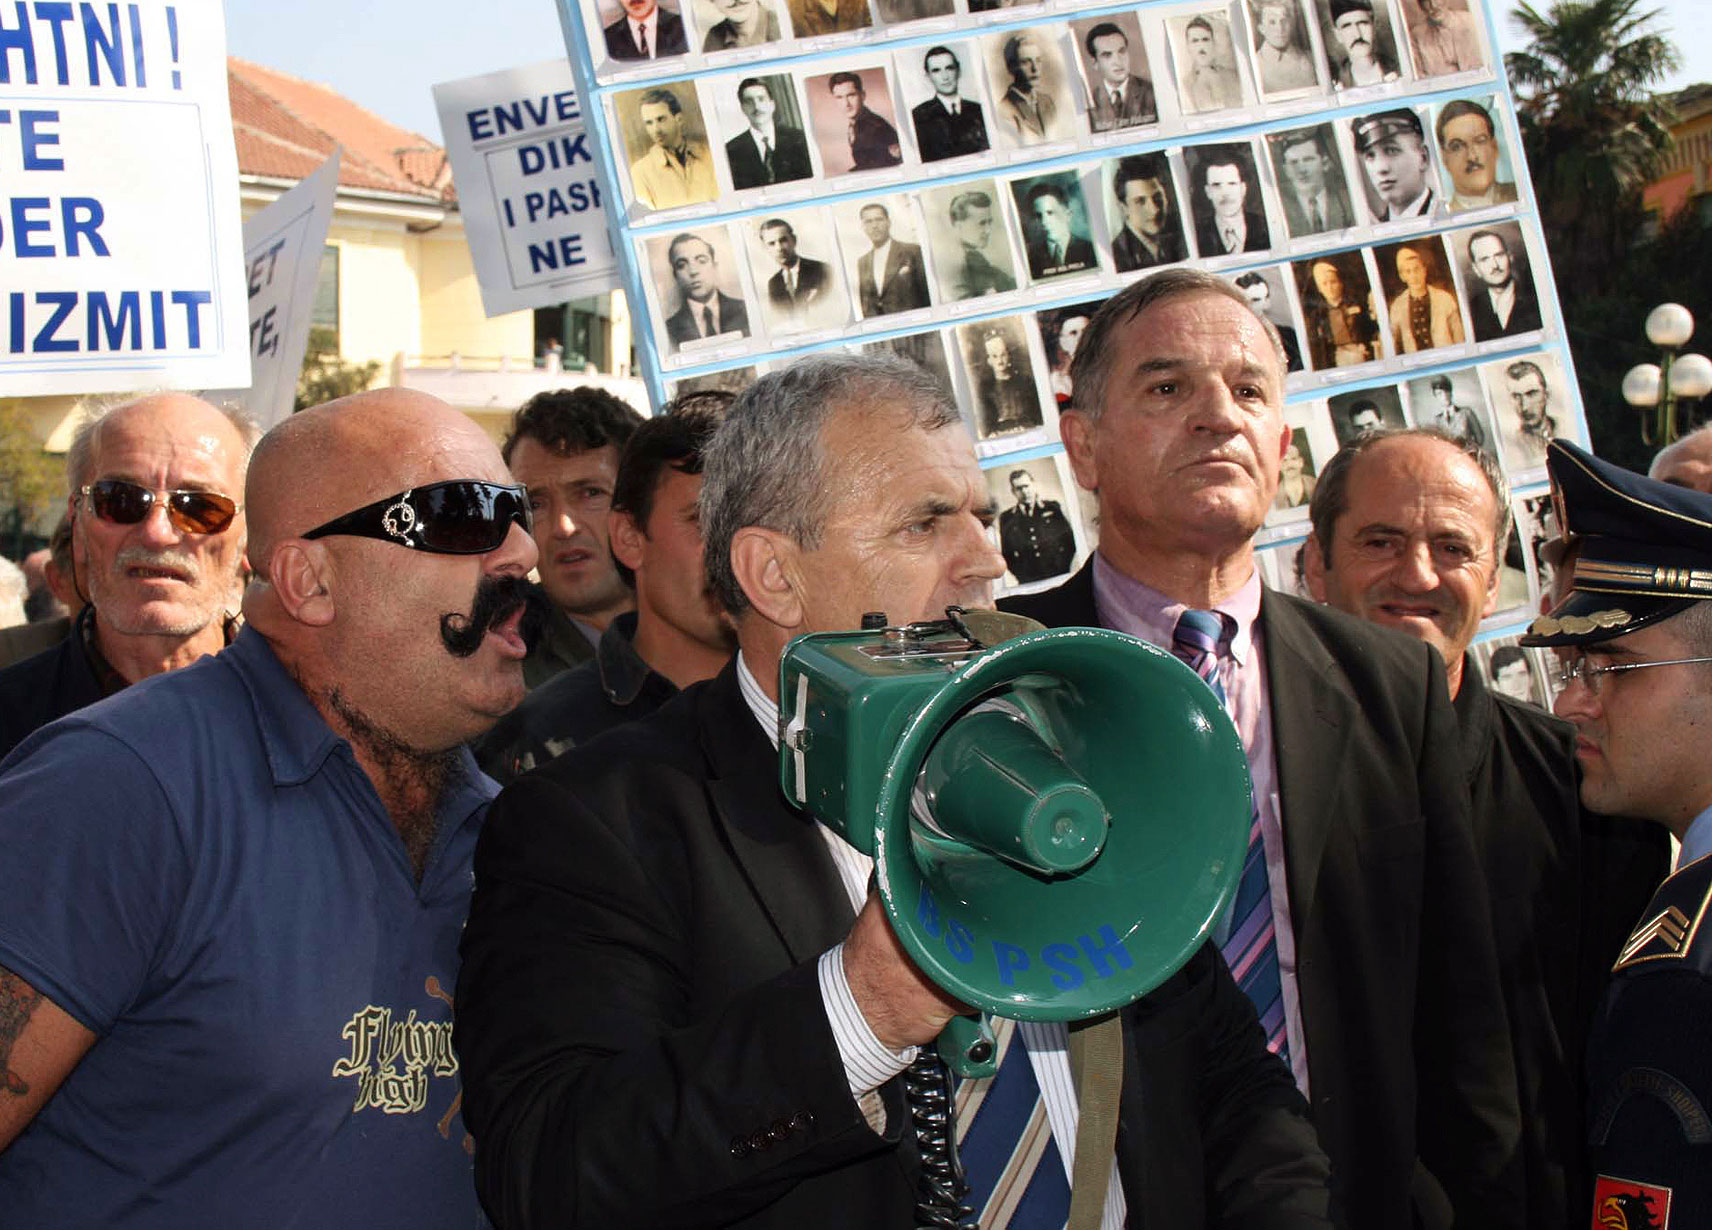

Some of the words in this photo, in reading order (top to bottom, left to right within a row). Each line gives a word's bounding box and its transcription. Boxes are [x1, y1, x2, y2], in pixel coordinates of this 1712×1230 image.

[466, 91, 581, 141] ENVE
[0, 109, 65, 171] E
[517, 133, 593, 176] DIK
[0, 196, 112, 258] ER
[503, 198, 516, 228] I
[528, 235, 586, 274] NE
